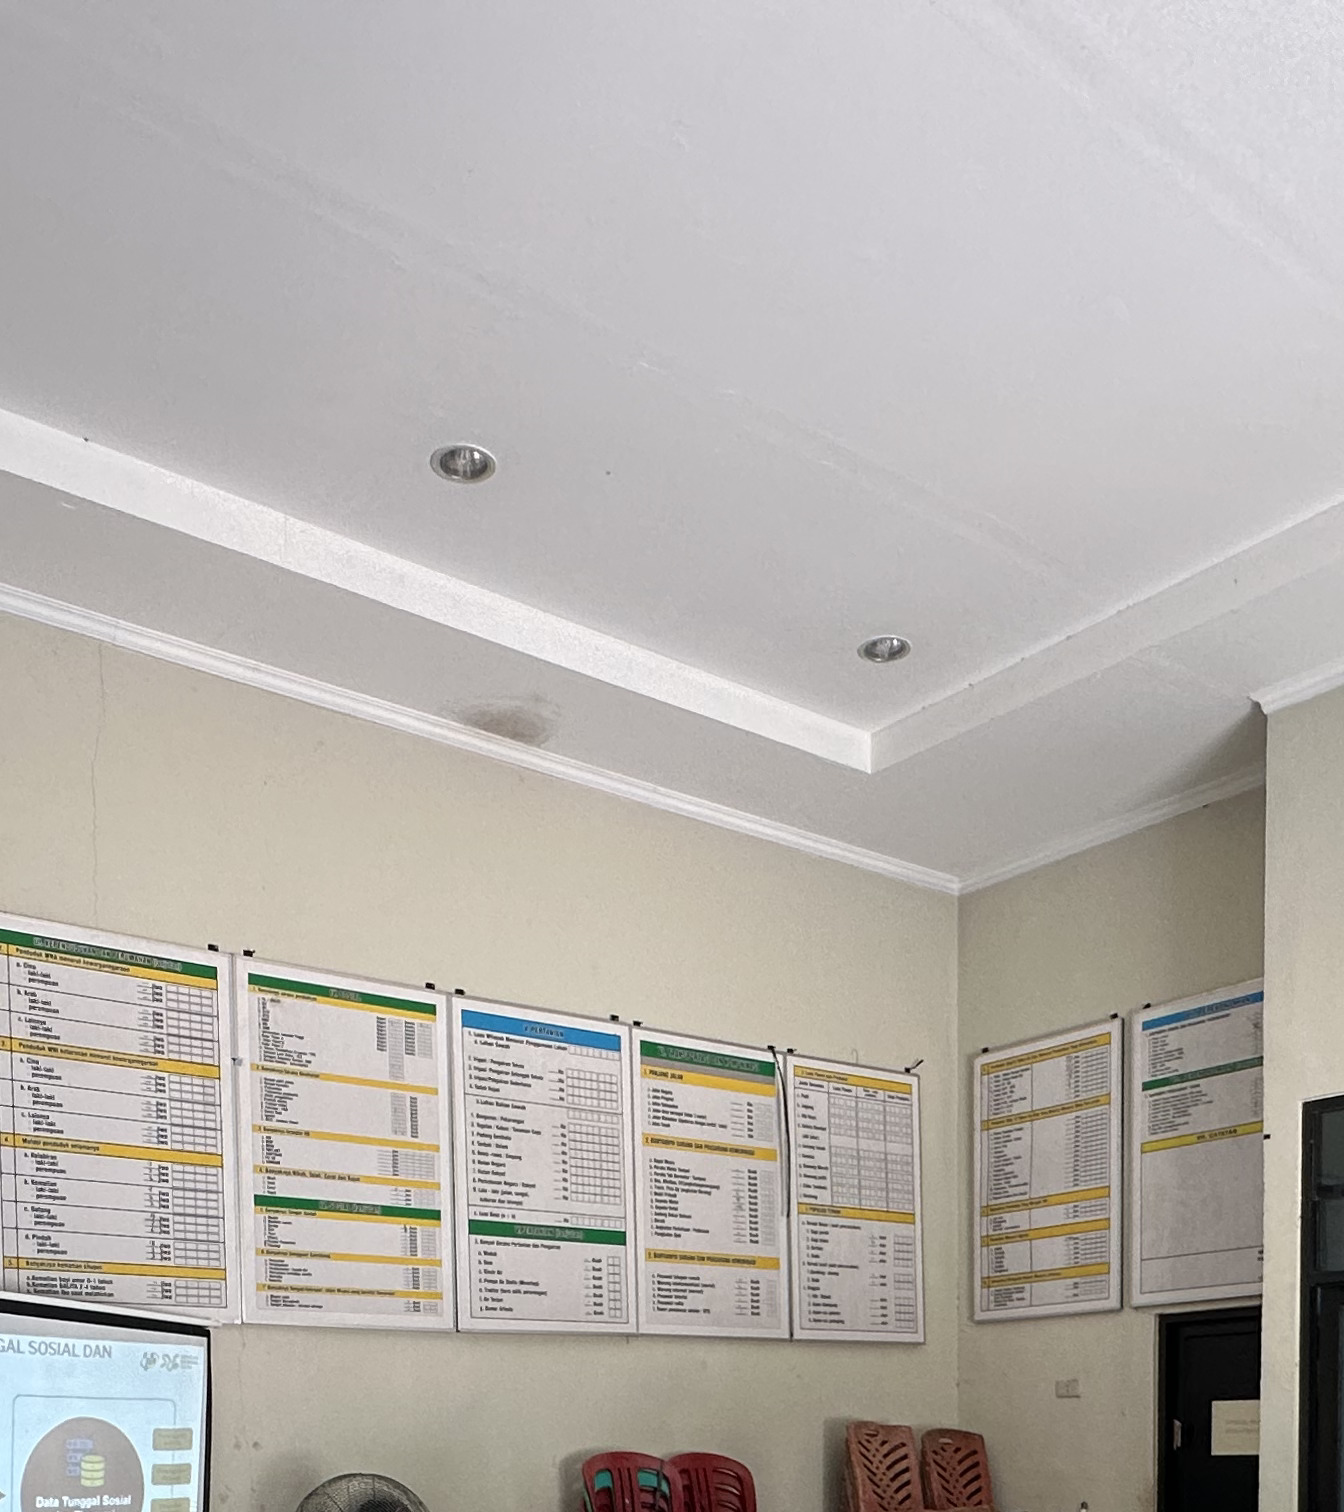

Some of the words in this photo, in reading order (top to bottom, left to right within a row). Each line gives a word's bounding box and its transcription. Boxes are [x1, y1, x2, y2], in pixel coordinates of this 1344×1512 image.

[28, 1339, 81, 1358] SOSIAL
[83, 1344, 113, 1359] DAN
[35, 1496, 59, 1508] Data
[62, 1495, 100, 1509] Tunggal
[101, 1494, 132, 1506] Sosial
